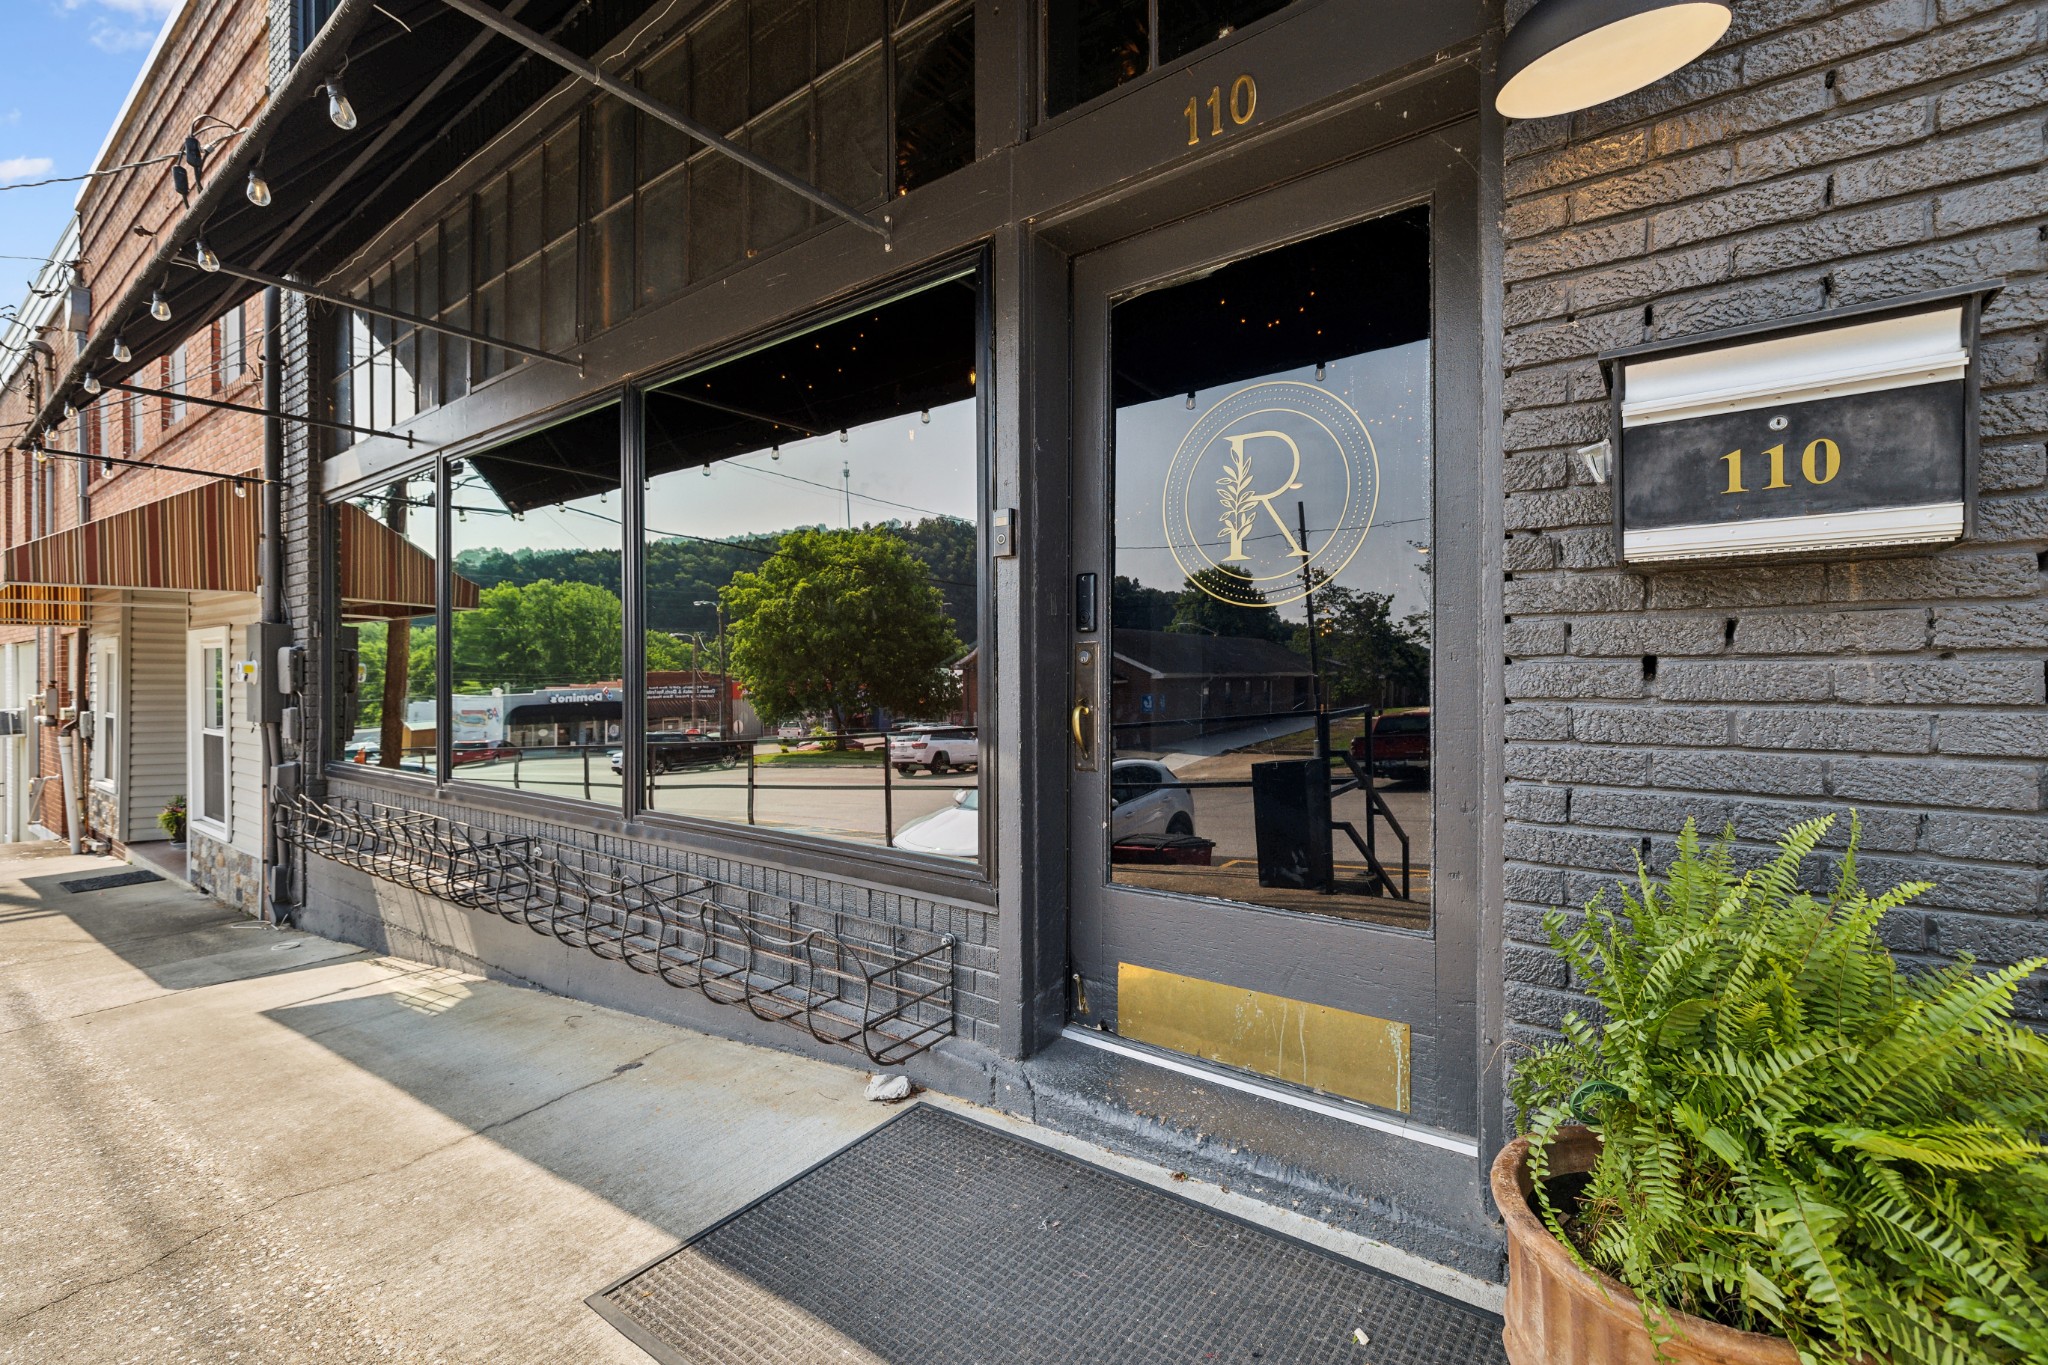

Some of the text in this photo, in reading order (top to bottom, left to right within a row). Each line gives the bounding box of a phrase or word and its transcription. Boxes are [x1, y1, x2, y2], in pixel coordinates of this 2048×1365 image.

[1183, 74, 1257, 145] 110
[1216, 430, 1312, 562] R
[1719, 438, 1841, 494] 110
